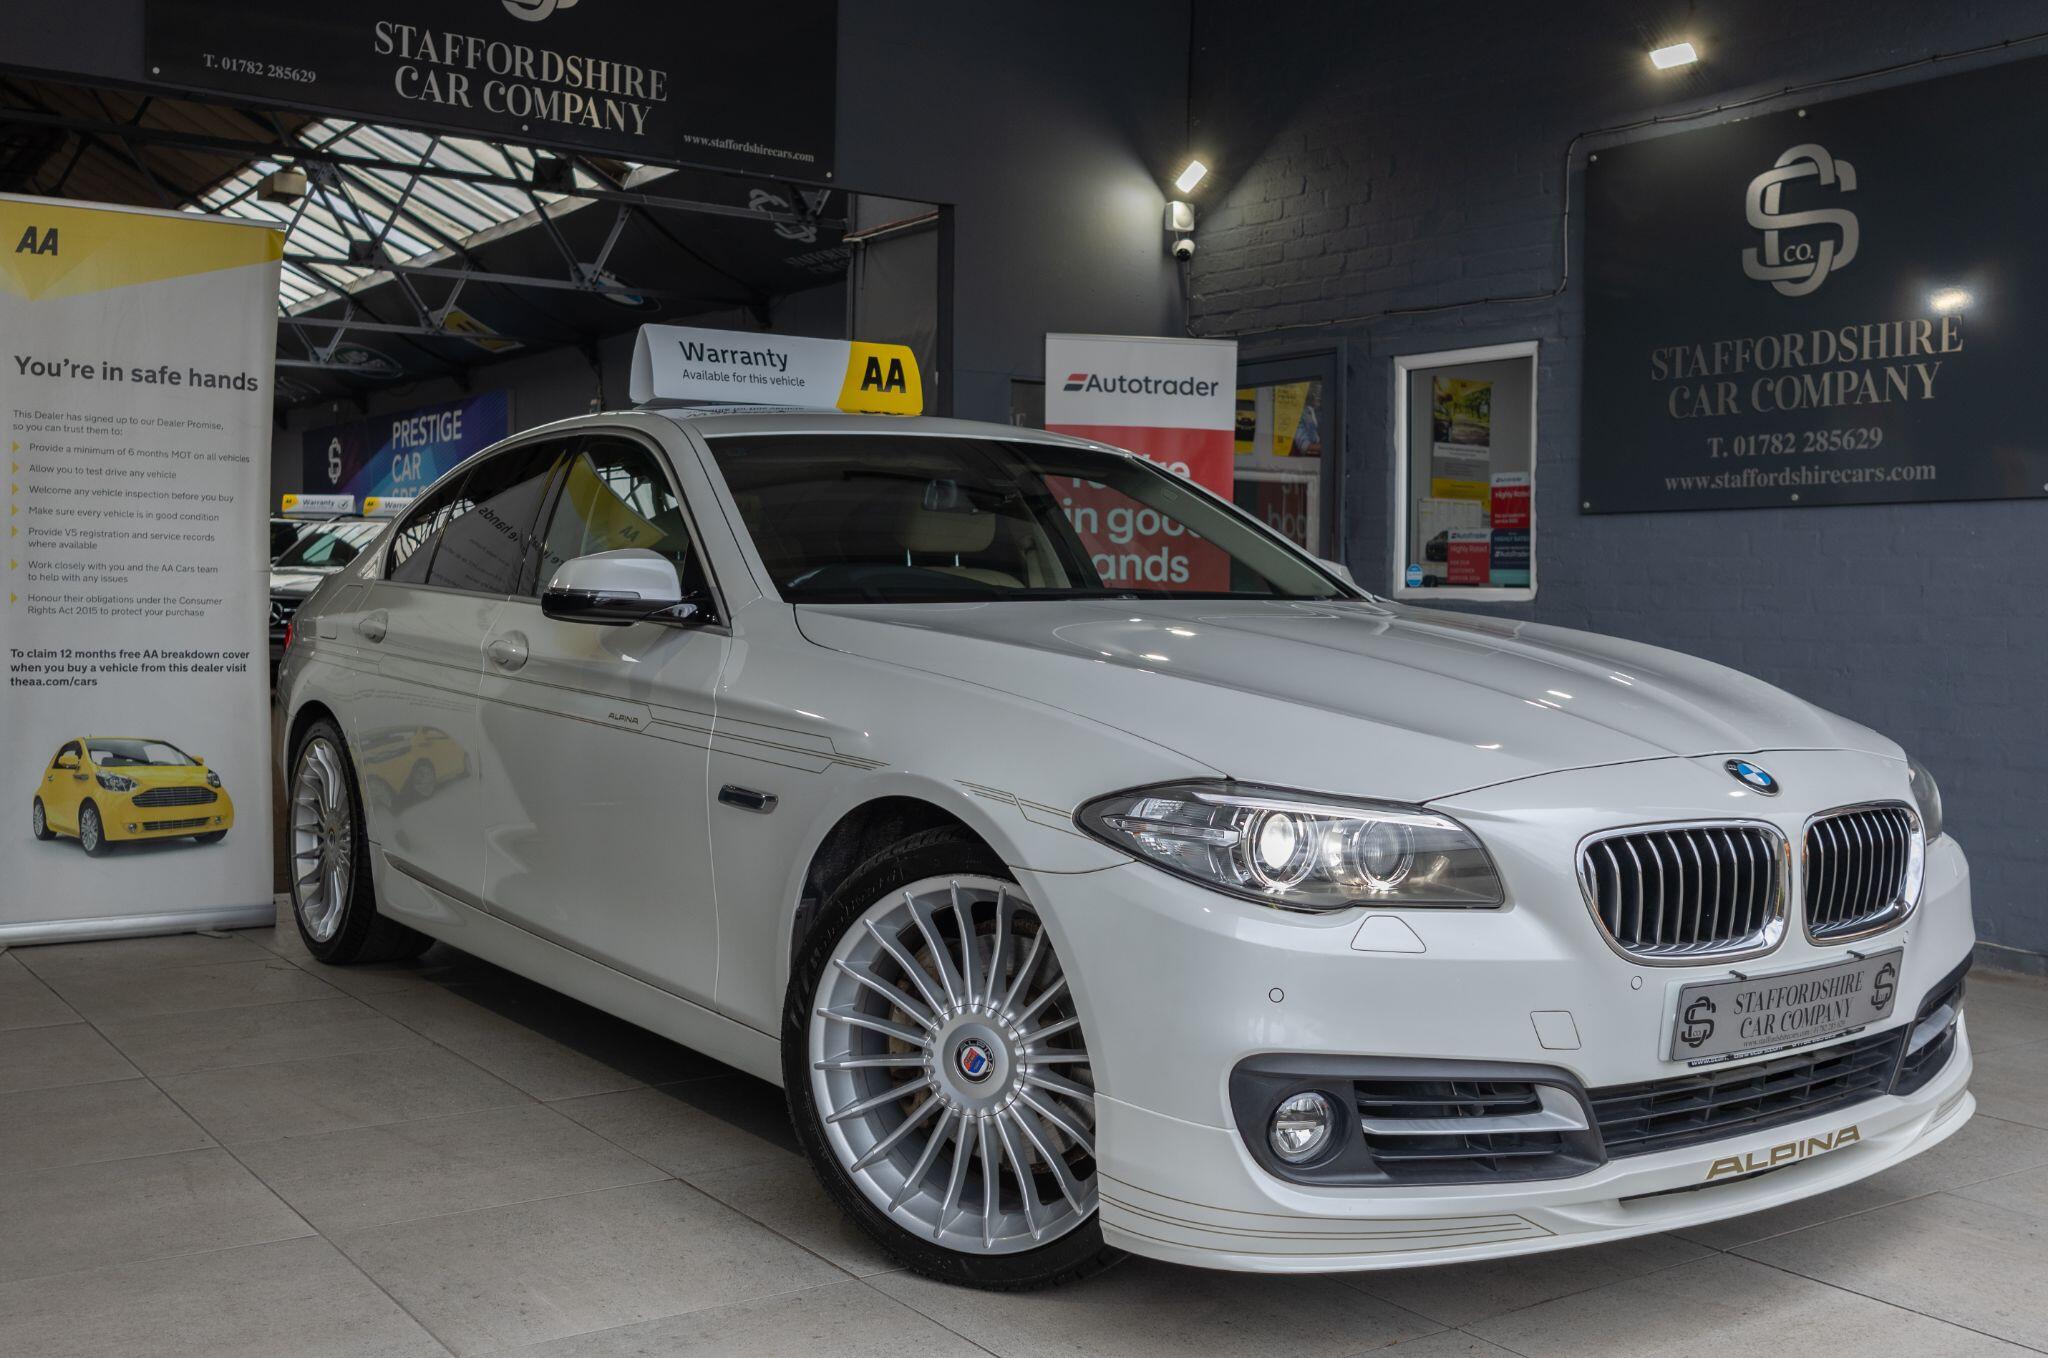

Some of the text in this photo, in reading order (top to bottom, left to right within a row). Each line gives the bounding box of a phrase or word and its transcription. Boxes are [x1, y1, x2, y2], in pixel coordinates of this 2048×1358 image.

[203, 53, 317, 83] T. 01782 285629
[374, 20, 667, 102] STAFFORDSHIRE
[394, 65, 652, 136] CAR COMPANY
[683, 134, 815, 162] www.staffordshirecars.com
[15, 226, 59, 256] AA
[678, 340, 788, 372] Warranty
[1650, 314, 1965, 382] STAFFORDSHIRE
[14, 355, 259, 392] You're in safe hands
[682, 369, 806, 387] Available for this vehicle
[860, 356, 907, 394] AA
[1085, 373, 1220, 398] Autotrader
[1668, 361, 1943, 420] CAR COMPANY
[12, 423, 123, 436] so you can trust them to:
[13, 409, 224, 431] This Dealer has signed up to our Dealer Promise,
[392, 410, 463, 449] PRESTIGE
[29, 443, 64, 453] Provide
[73, 445, 115, 455] minimum
[117, 447, 126, 456] of
[128, 448, 135, 456] 6
[136, 449, 169, 458] months
[171, 451, 192, 460] MOT
[207, 452, 217, 461] all
[218, 453, 250, 463] vehicles
[1707, 426, 1883, 459] T. 01782 285629
[29, 464, 177, 479] Allow you to test drive any vehicle
[392, 452, 421, 483] CAR
[1665, 464, 1937, 491] www.staffordshirecars.com
[28, 485, 234, 503] Welcome any vehicle inspection before you buy
[302, 499, 335, 507] Warranty
[28, 506, 220, 521] Make sure every vehicle is in good condition
[1107, 507, 1200, 544] goo
[28, 527, 215, 542] Provide V5 registration and service records
[28, 539, 98, 550] where available
[28, 560, 218, 573] Work closely with you and the AA Cars team
[1091, 546, 1189, 583] ands
[27, 573, 129, 584] to help with any issues
[27, 594, 223, 605] Honour their obligations under the Consumer
[27, 605, 205, 617] Rights Act 2015 to protect your purchase
[10, 648, 250, 659] To claim 12 months free AA breakdown cover
[10, 663, 247, 674] when you buy a vehicle from this dealer visit
[10, 676, 98, 687] theaa.com/cars
[608, 712, 639, 725] ALPINA
[1734, 971, 1864, 1015] STAFFORDSHIRE
[1740, 1013, 1775, 1039] CAR
[1780, 997, 1854, 1032] COMPANY
[1704, 1125, 1861, 1180] ALPINA
